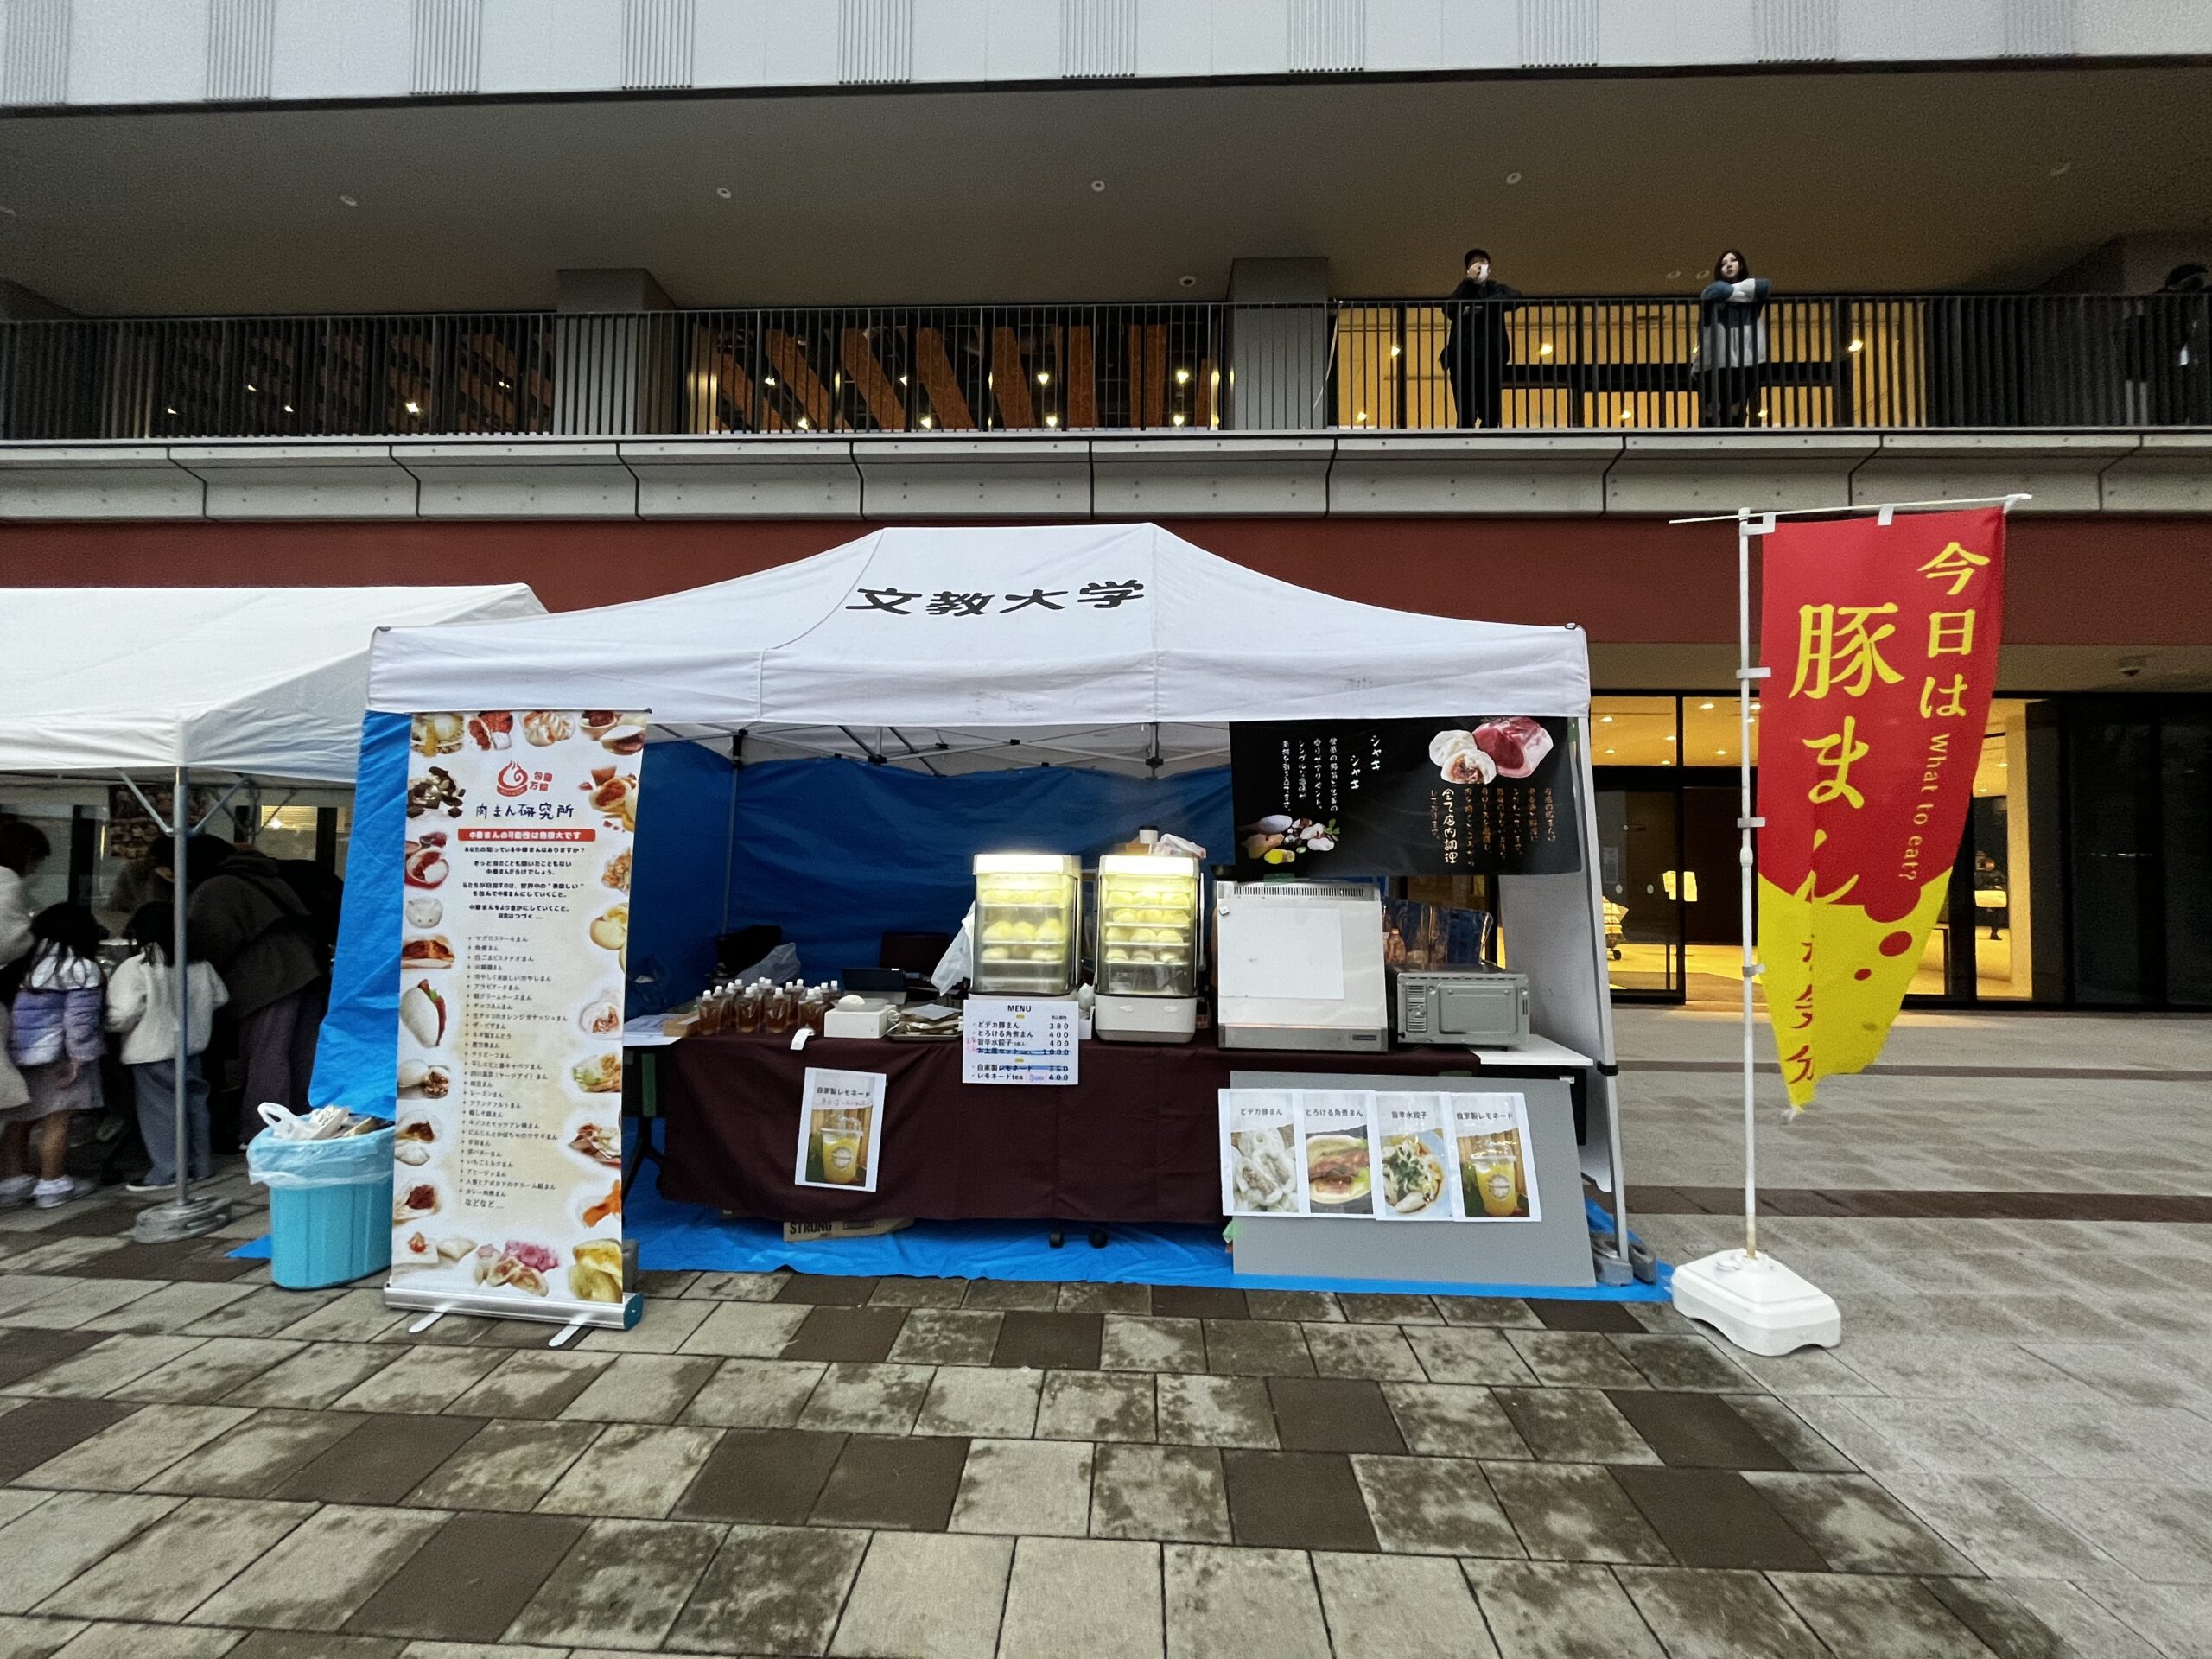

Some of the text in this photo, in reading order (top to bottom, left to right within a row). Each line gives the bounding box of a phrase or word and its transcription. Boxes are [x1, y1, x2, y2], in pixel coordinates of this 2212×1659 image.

[846, 580, 1144, 616] 文教大学
[1917, 542, 1990, 718] 今日は
[1789, 602, 1905, 905] 豚まん
[475, 803, 574, 820] 肉まん研究所
[1898, 733, 1951, 880] What to eat?
[1441, 788, 1459, 864] 全て店内調理
[817, 1086, 871, 1097] 自家製レモネード
[1306, 1109, 1363, 1117] とろける角煮まん
[790, 1220, 833, 1235] STRONG
